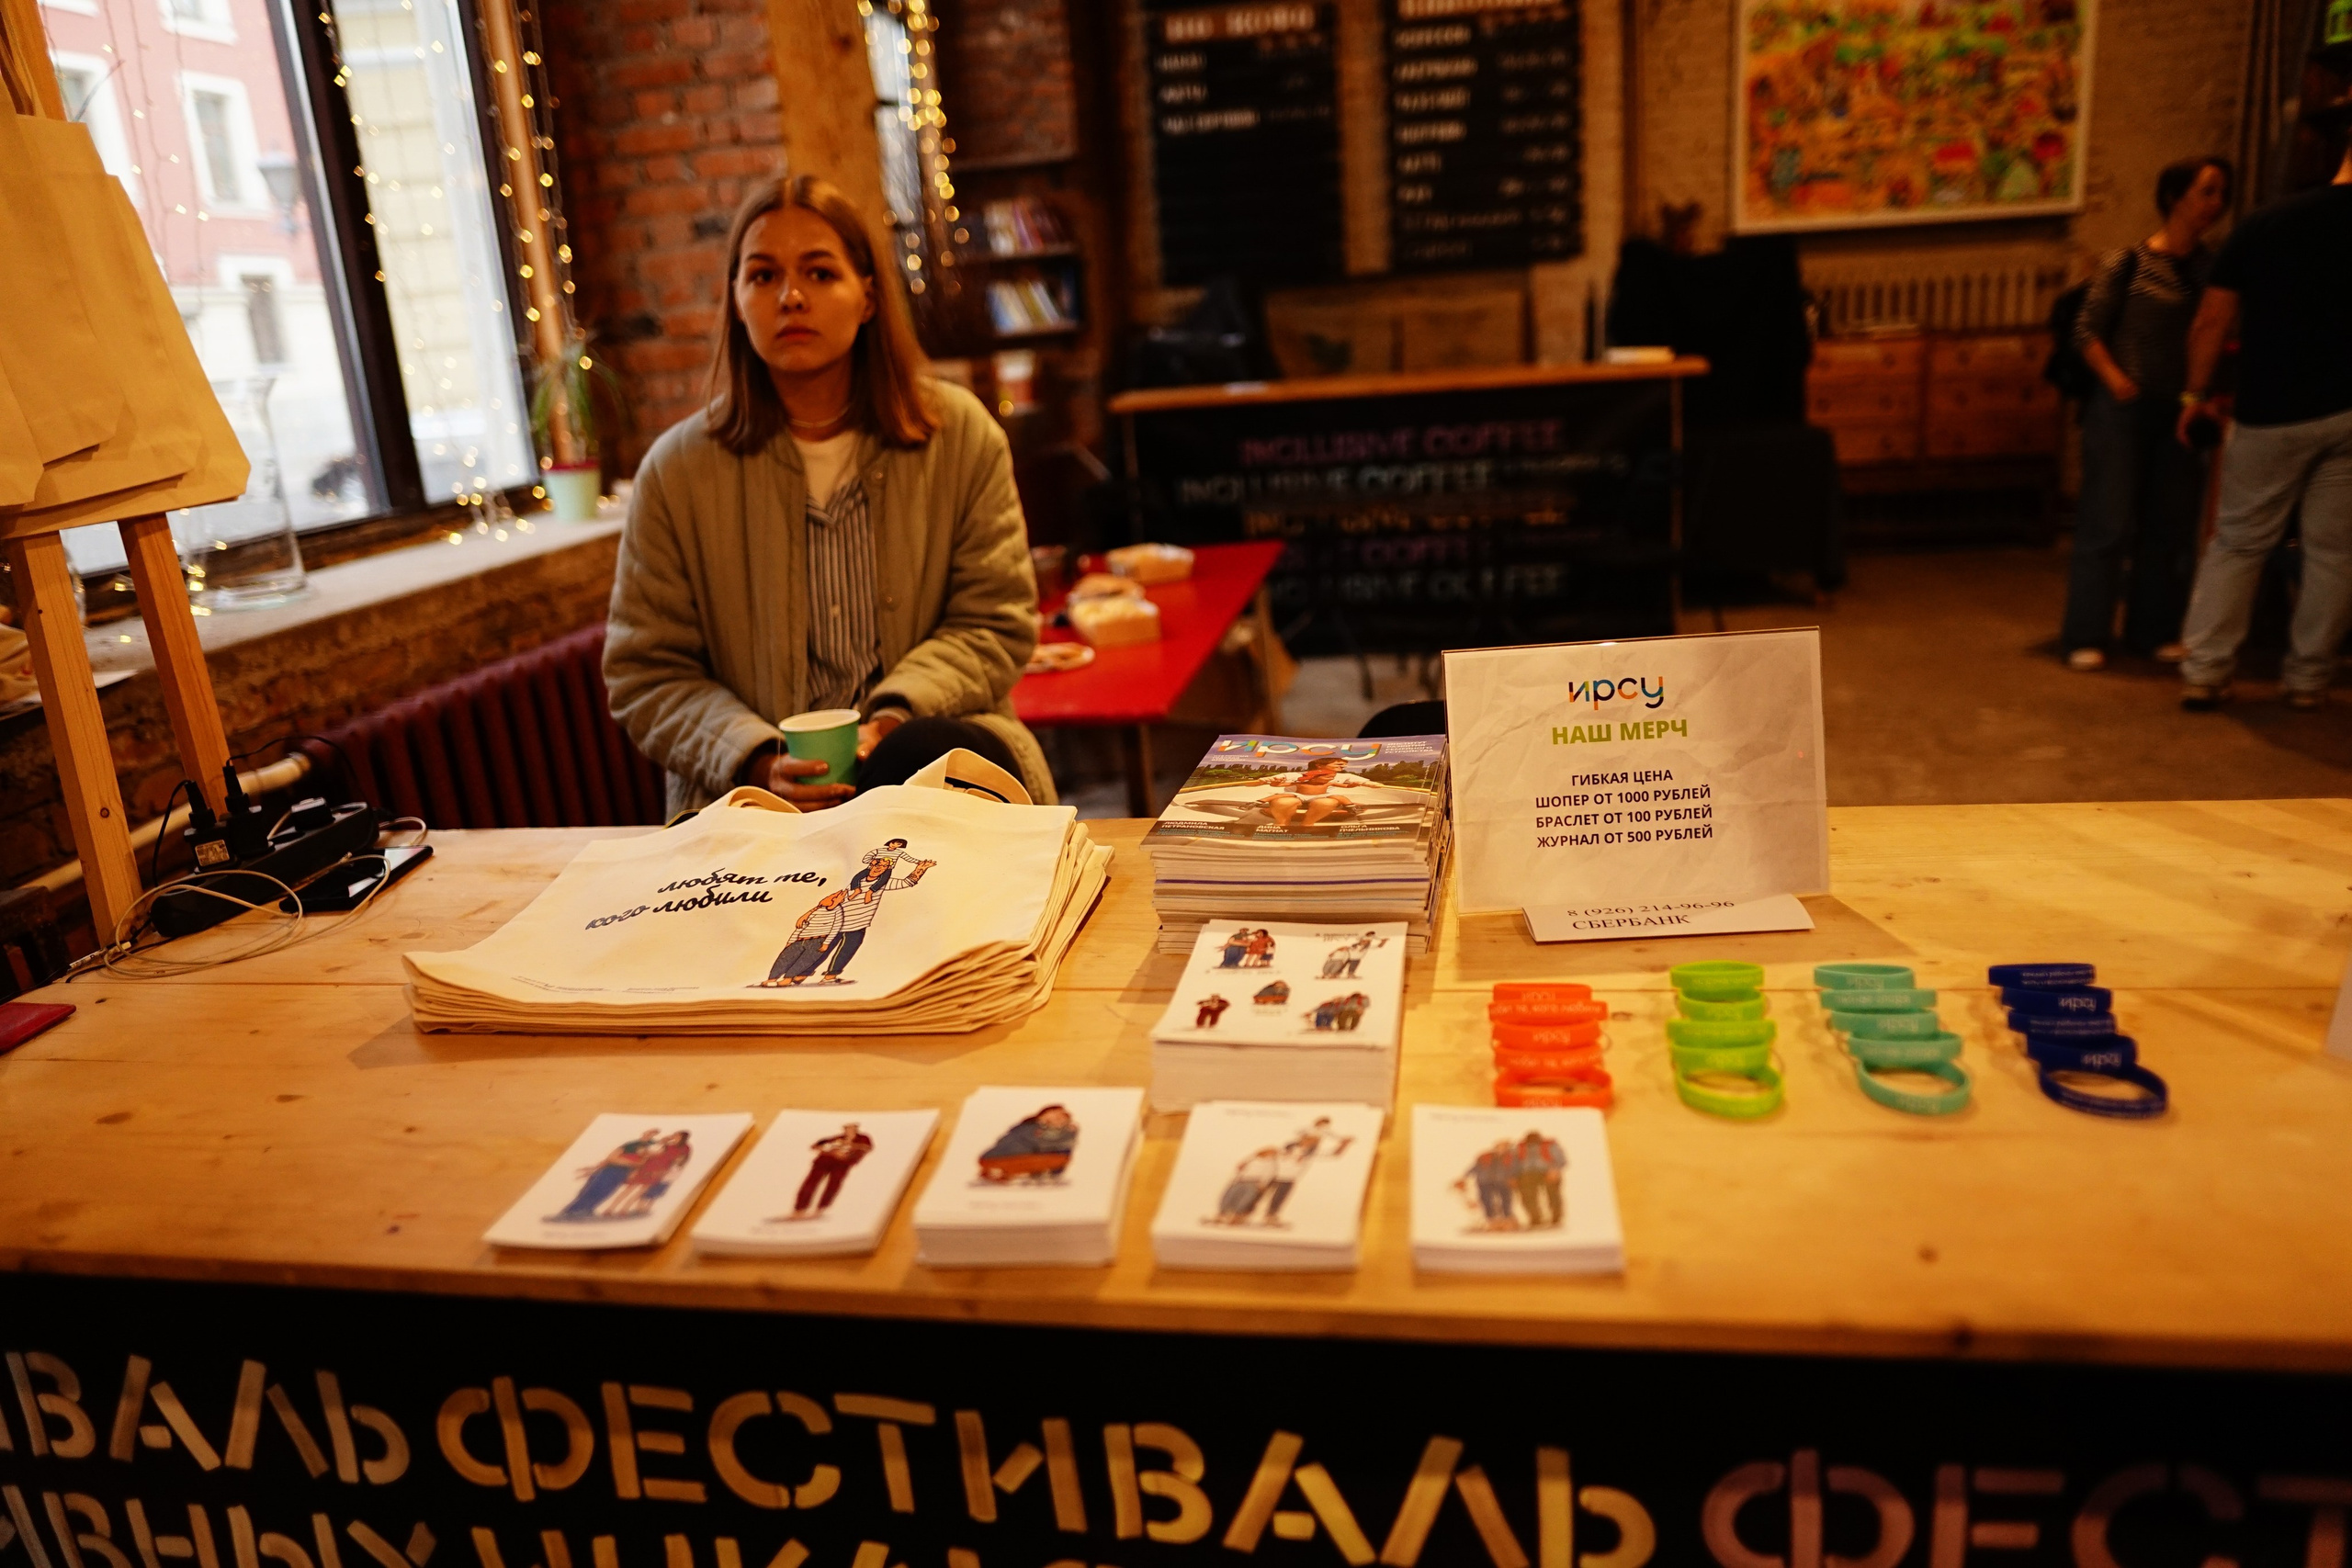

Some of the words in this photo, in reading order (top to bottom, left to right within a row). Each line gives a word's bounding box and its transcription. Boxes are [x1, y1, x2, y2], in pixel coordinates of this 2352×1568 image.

[1552, 724, 1611, 745] НАШ
[1620, 719, 1688, 740] МЕРЧ
[1571, 772, 1629, 786] ГИБКАЯ
[1634, 769, 1673, 784] ЦЕНА
[1536, 795, 1589, 808] ШОПЕР
[1594, 793, 1612, 805] ОТ
[1617, 791, 1649, 804] 1000
[1654, 784, 1711, 802] РУБЛЕЙ
[1536, 814, 1600, 829] БРАСЛЕТ
[1603, 812, 1623, 824] ОТ
[1627, 810, 1651, 823] 100
[1656, 804, 1713, 821] РУБЛЕЙ
[1537, 832, 1600, 848] ЖУРНАЛ
[1604, 831, 1623, 844] ОТ
[1627, 830, 1652, 843] 500
[1656, 824, 1713, 841] РУБЛЕЙ
[657, 867, 768, 894] любят
[774, 872, 827, 887] те,
[585, 905, 650, 931] кого
[652, 884, 774, 913] любили
[1584, 907, 1634, 917] (926)
[1638, 900, 1735, 913] 214-96-96
[1572, 915, 1691, 930] СБЕРБАНК
[436, 1375, 1657, 1568] ФЕСТИВАЛЬ
